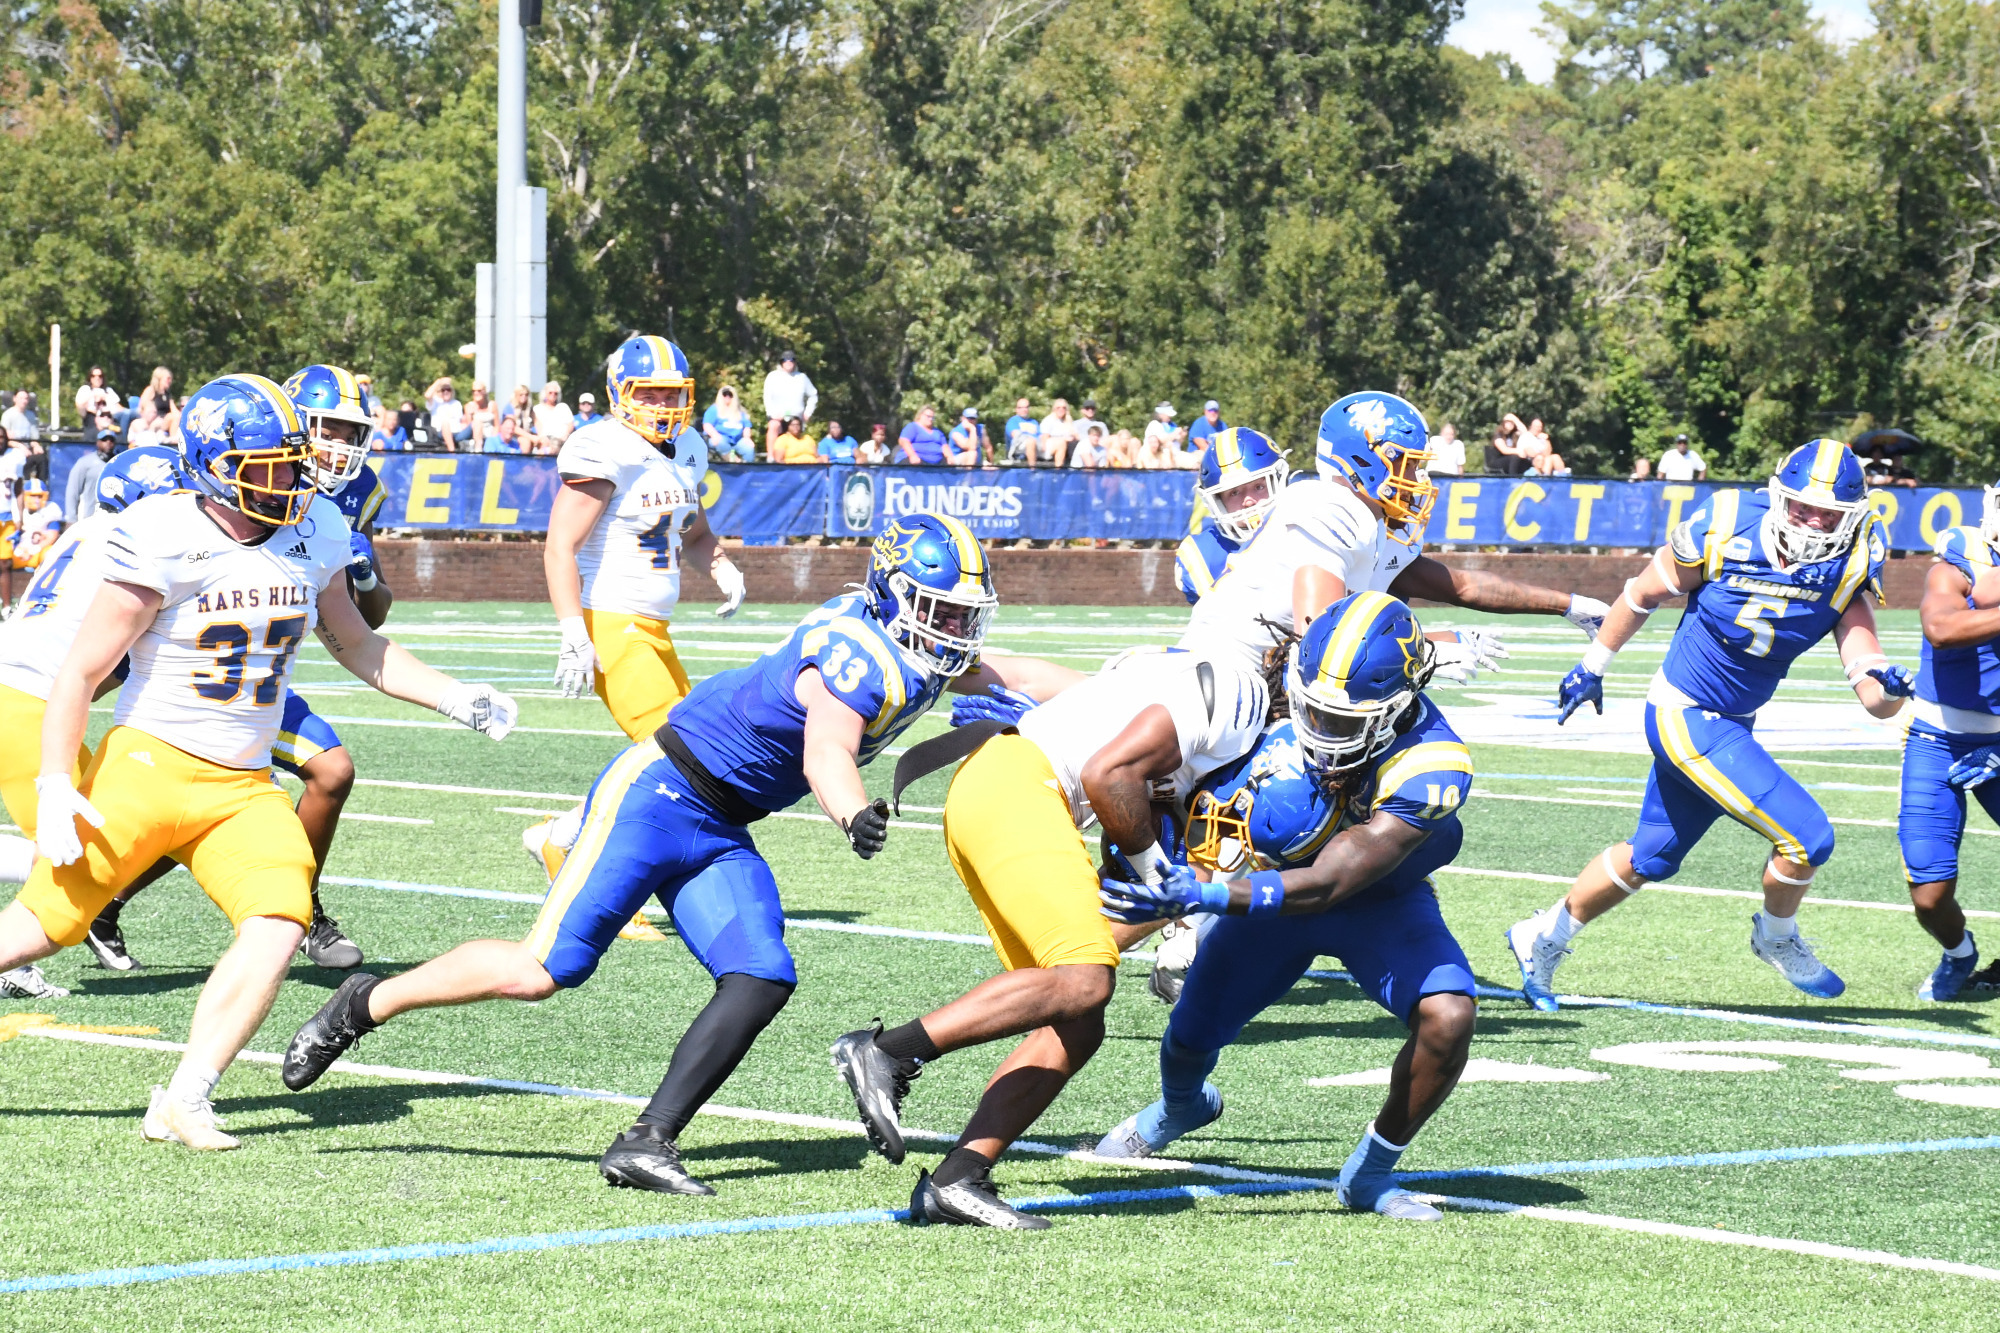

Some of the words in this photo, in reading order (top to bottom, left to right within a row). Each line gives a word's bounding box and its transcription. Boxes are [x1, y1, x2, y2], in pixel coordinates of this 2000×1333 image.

[641, 488, 680, 507] MARS
[883, 477, 1022, 517] FOUNDERS
[187, 550, 211, 564] SAC
[284, 550, 312, 561] adidas
[196, 588, 260, 613] MARS
[269, 583, 309, 606] HILL
[1734, 593, 1789, 658] 5
[189, 612, 309, 707] 37
[822, 640, 869, 693] 33
